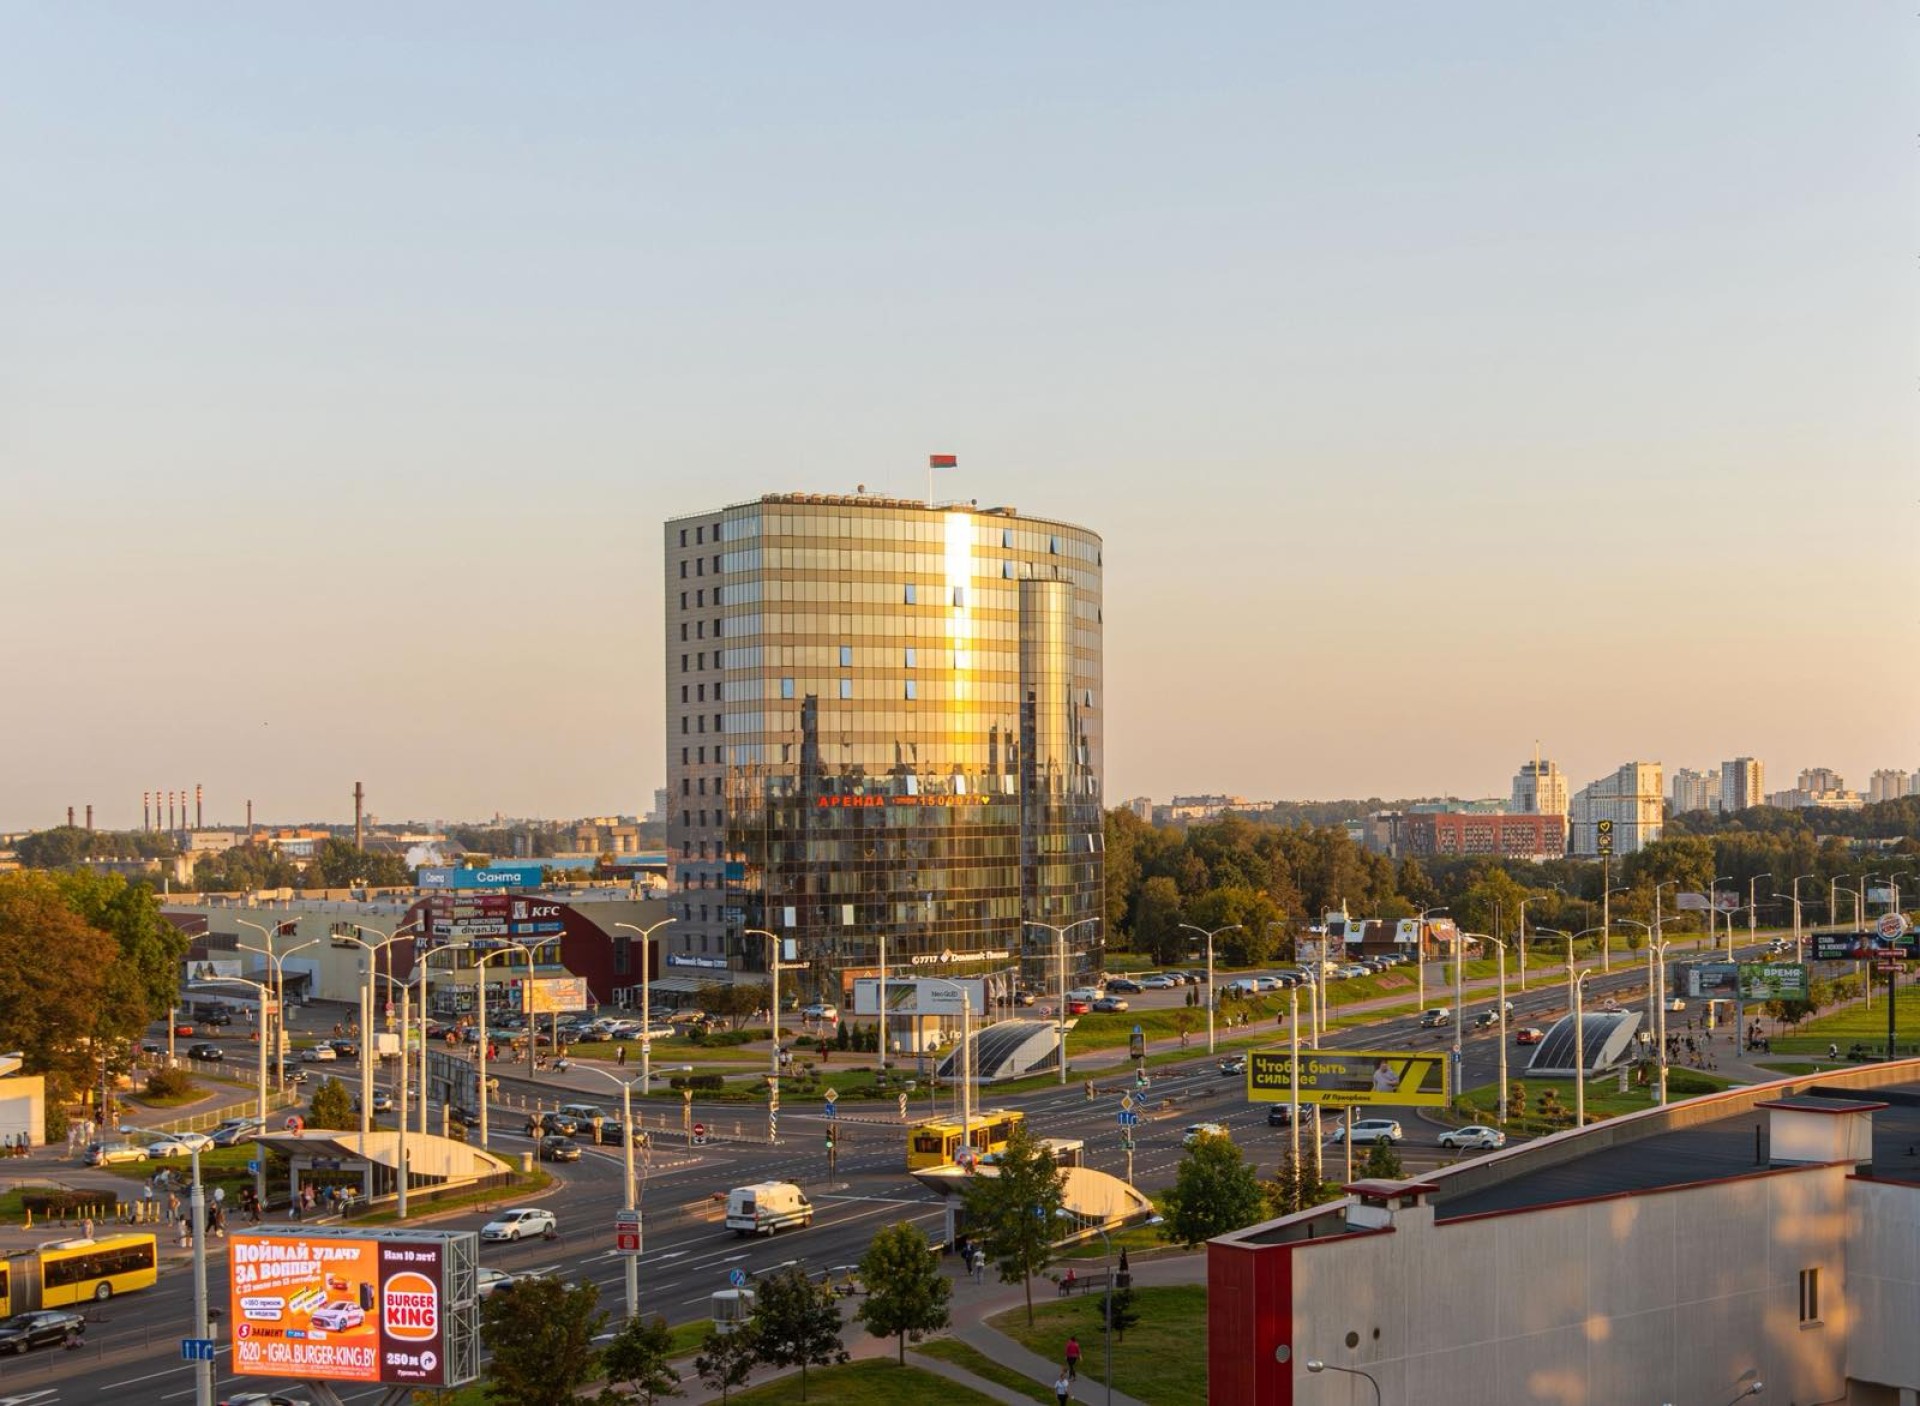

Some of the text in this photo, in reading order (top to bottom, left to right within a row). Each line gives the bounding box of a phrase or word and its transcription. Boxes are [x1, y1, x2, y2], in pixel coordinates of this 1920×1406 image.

[818, 795, 884, 807] АРЕНДА
[476, 871, 522, 882] Санта
[531, 906, 561, 917] KFC
[461, 926, 501, 935] divan.by
[1308, 1060, 1346, 1074] быть
[1256, 1073, 1317, 1085] сильее
[235, 1240, 361, 1263] ПОЙМАЙ УДАЧУ
[384, 1250, 437, 1262] Нам 10 лет!
[235, 1260, 322, 1284] ЗА ВОППЕР!
[387, 1294, 435, 1308] BURGER
[387, 1307, 436, 1326] KING
[238, 1341, 377, 1367] 7620 IGRA.BURGER-KING.BY
[387, 1353, 419, 1366] 250 м
